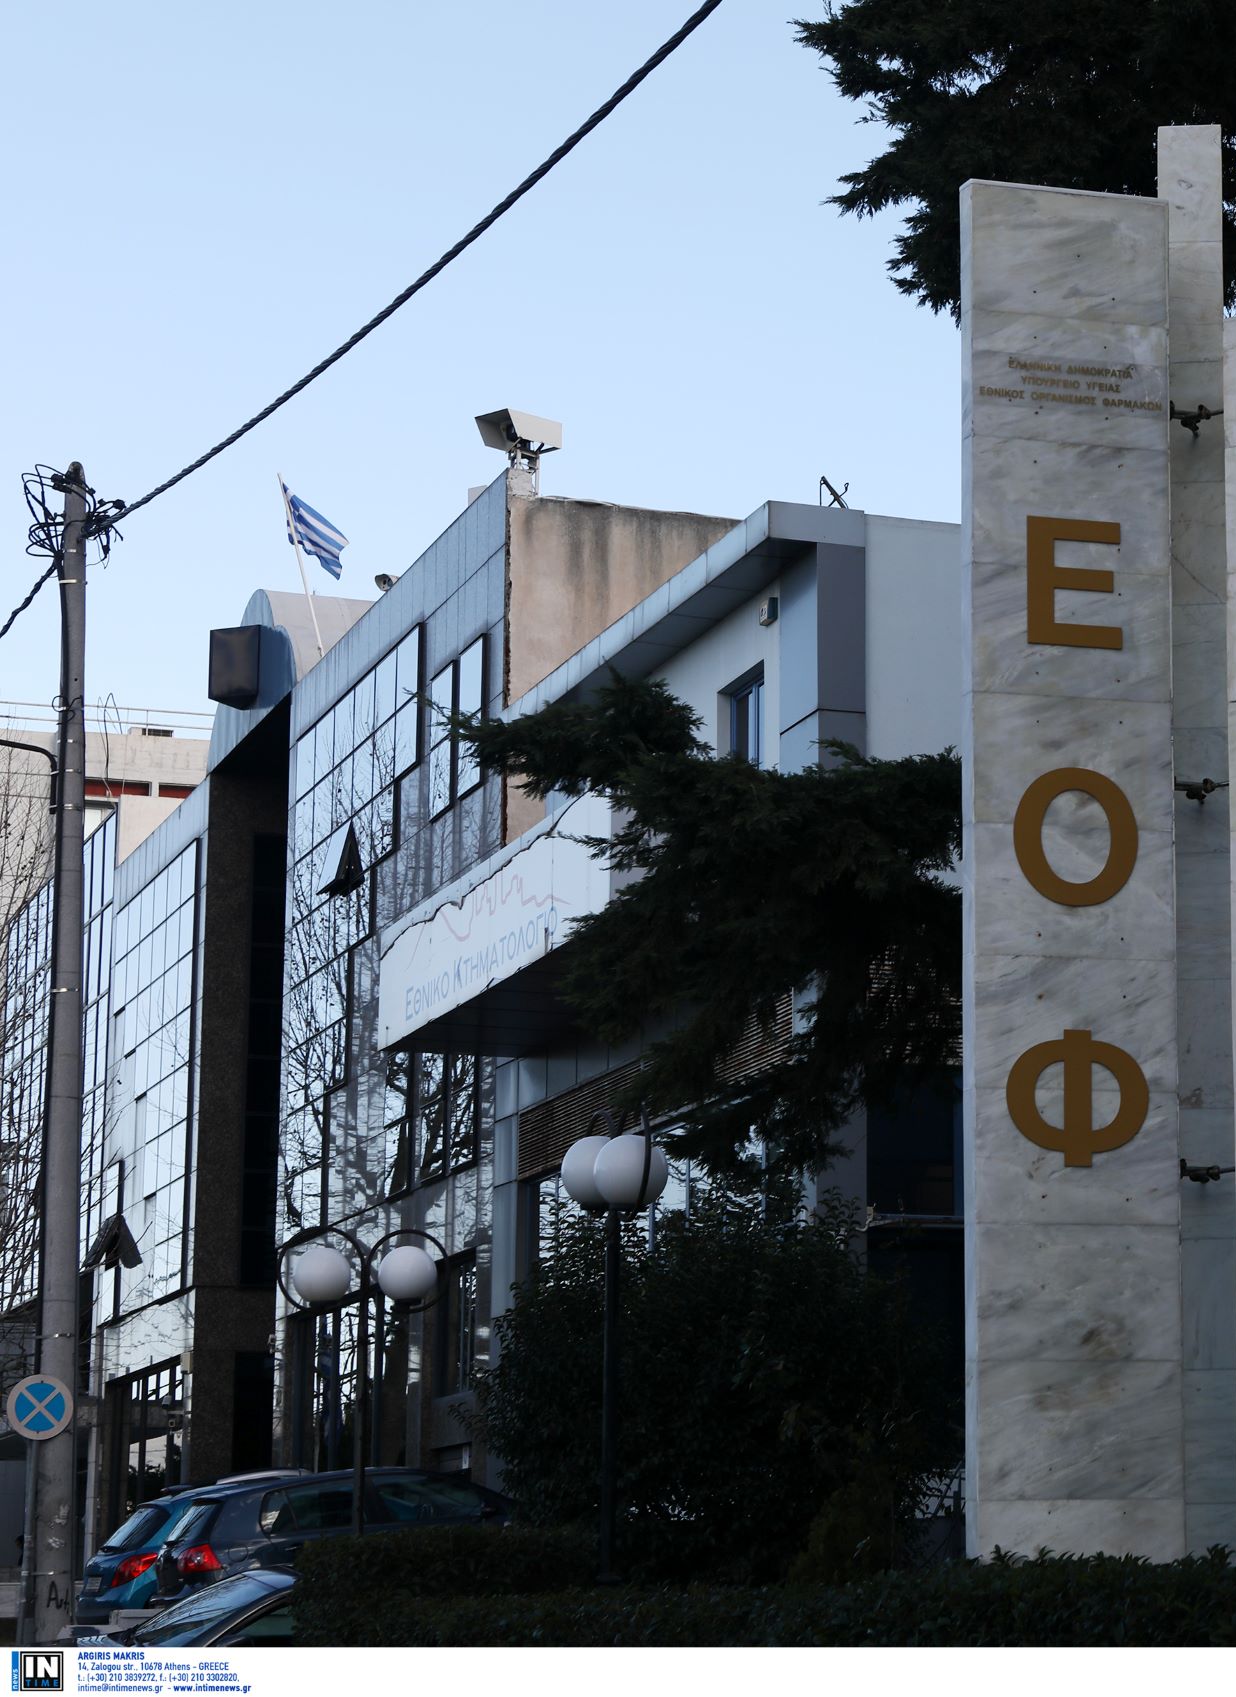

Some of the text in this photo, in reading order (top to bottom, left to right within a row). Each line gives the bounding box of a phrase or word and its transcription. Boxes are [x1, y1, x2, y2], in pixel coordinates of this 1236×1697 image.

[1066, 365, 1134, 379] ΔΗΜΟΚΡΑΤΙΑ
[1021, 376, 1122, 393] ΥΠΟΥΡΓΕΙΟ ΥΓΕΙΑΣ
[979, 386, 1025, 400] ΕΘΝΙΚΟΣ
[1006, 515, 1149, 1167] ΕΟΦ
